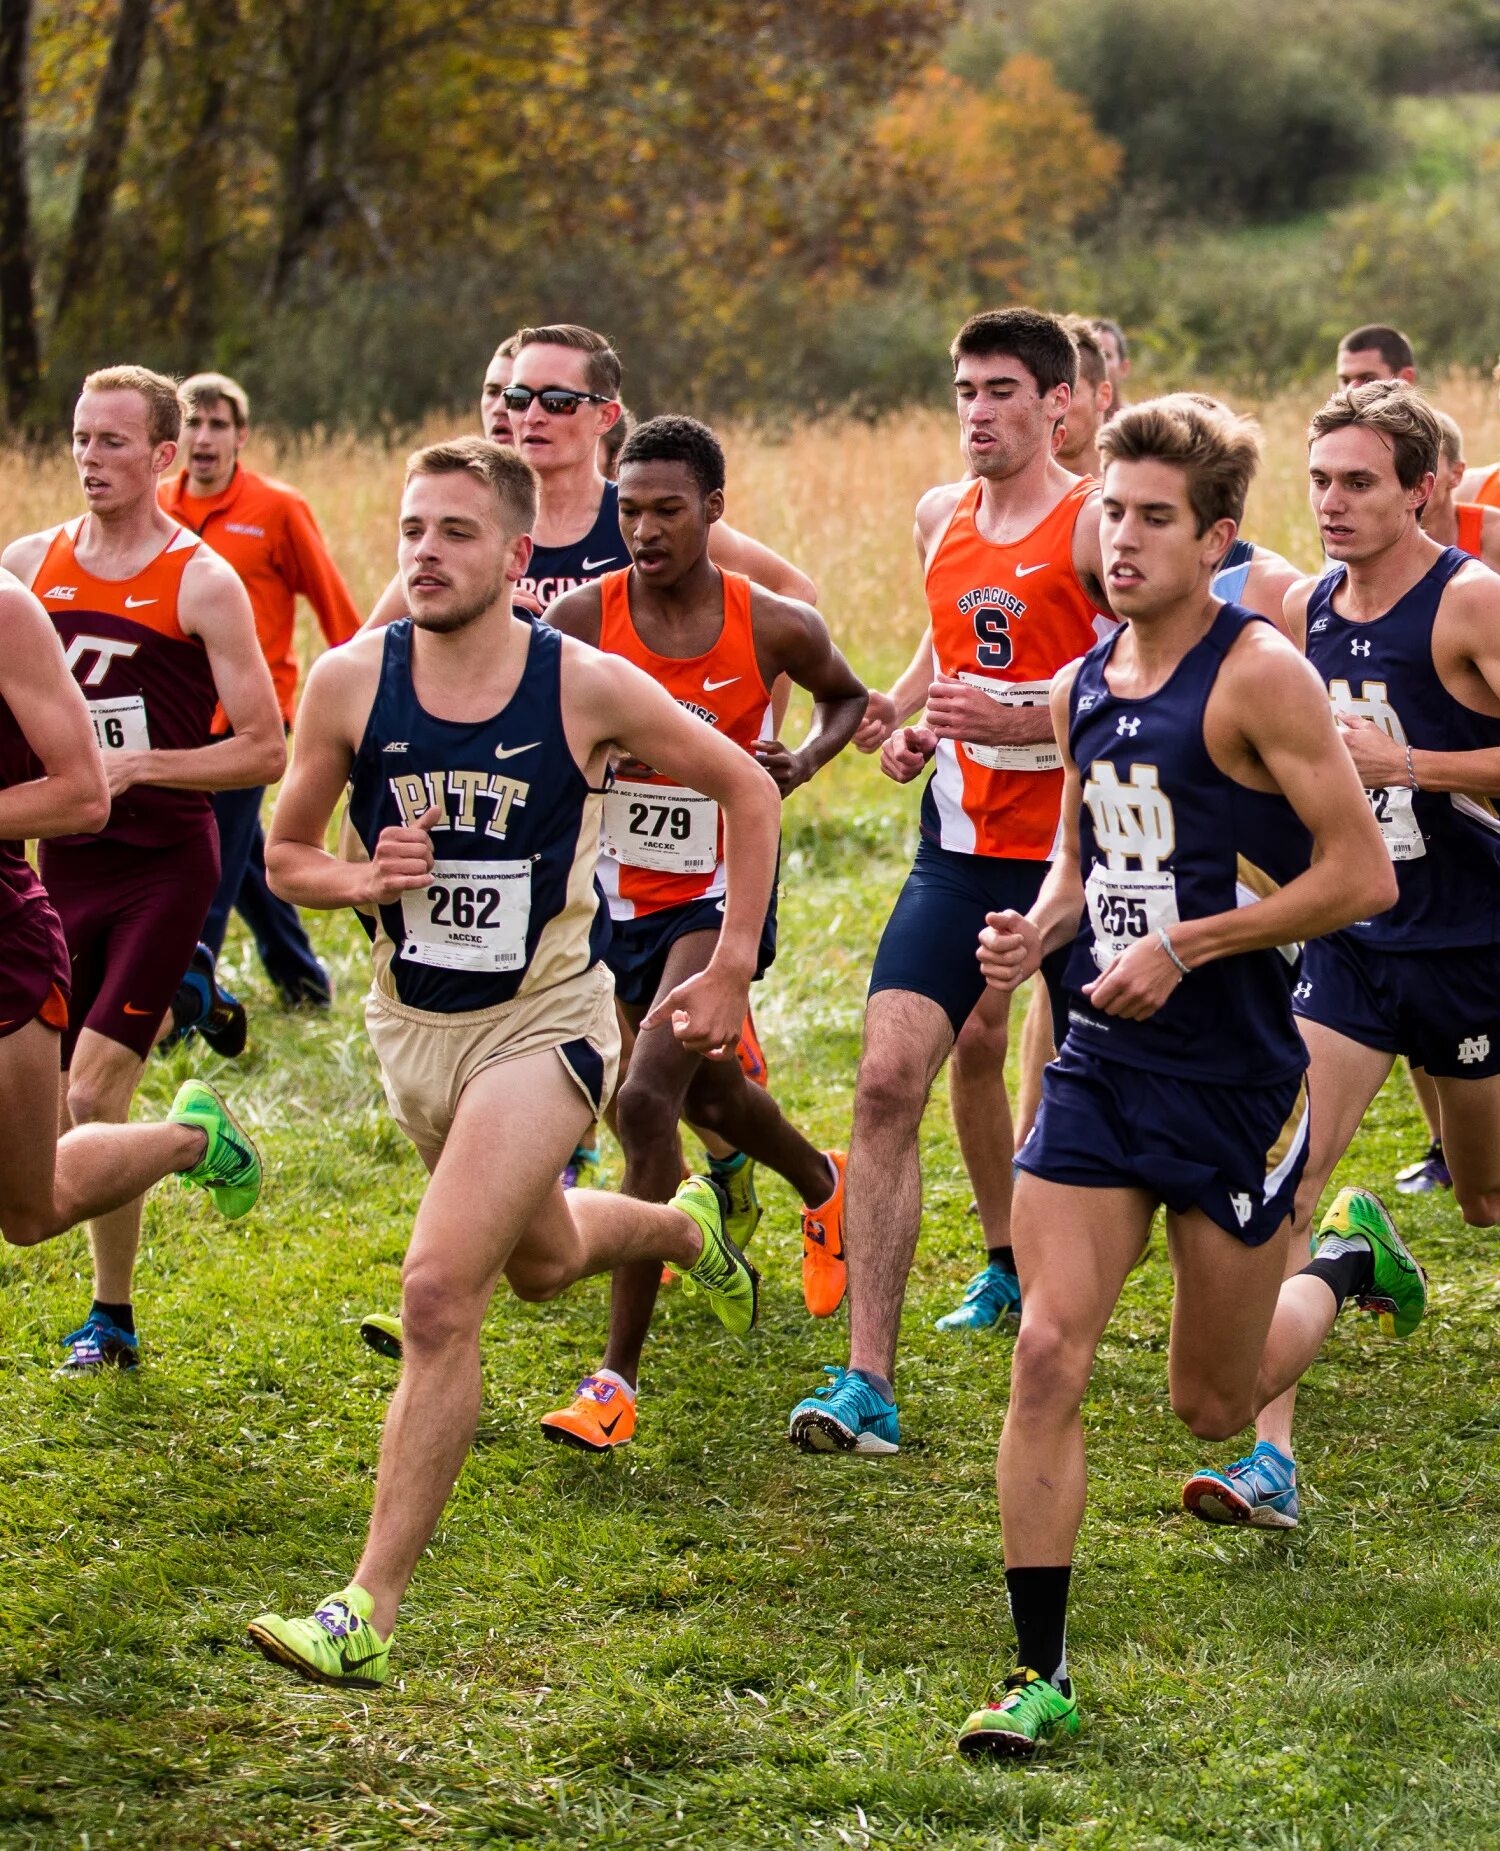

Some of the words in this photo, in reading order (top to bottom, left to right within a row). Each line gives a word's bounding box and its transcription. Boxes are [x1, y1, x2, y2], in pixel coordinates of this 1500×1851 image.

[44, 586, 78, 600] ACC
[957, 586, 1027, 619] SYRACUSE
[973, 607, 1013, 669] S
[1310, 618, 1328, 632] ACC
[383, 742, 409, 753] ACC
[388, 770, 530, 840] PITT
[629, 803, 691, 840] 279
[427, 885, 500, 929] 262
[1097, 893, 1149, 938] 255
